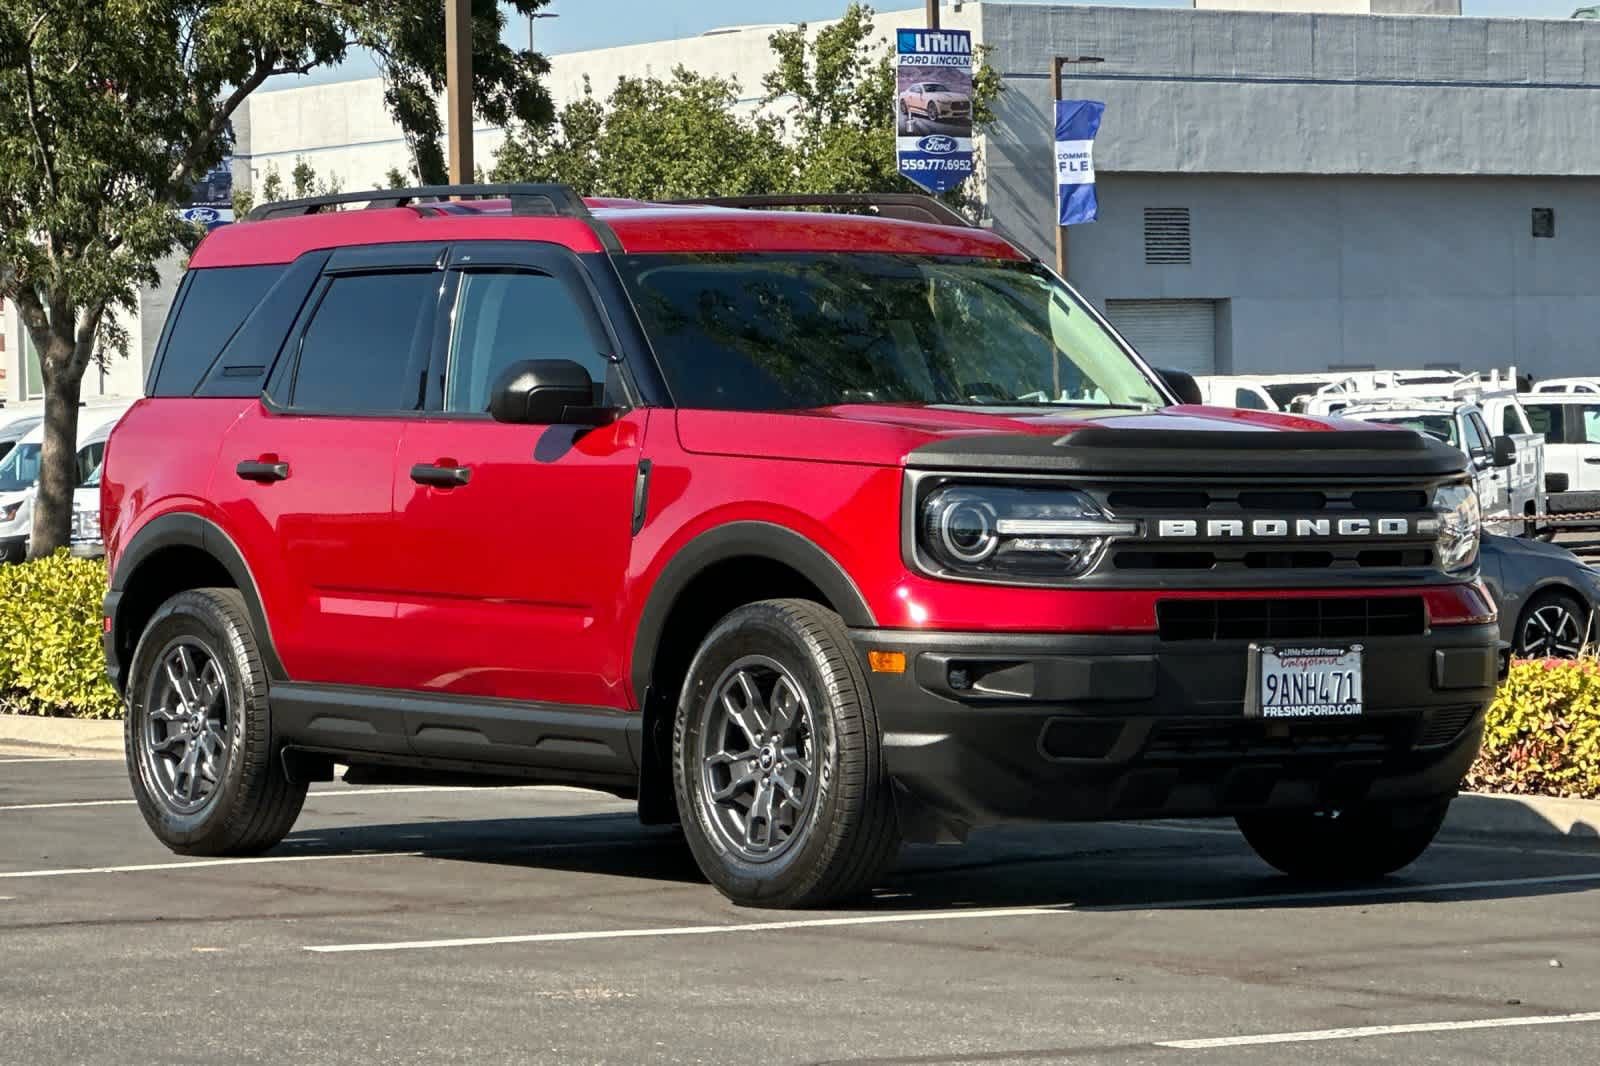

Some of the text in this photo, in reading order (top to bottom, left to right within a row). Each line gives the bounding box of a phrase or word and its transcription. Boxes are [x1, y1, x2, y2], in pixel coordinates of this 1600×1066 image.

[915, 32, 970, 53] LITHIA
[900, 55, 970, 66] FORD LINCOLN
[925, 137, 953, 152] Ford
[1058, 152, 1091, 160] COMME
[901, 159, 972, 171] 559.777.6952
[1159, 518, 1409, 537] BRONCO
[1281, 656, 1344, 672] California
[1266, 672, 1357, 705] 9ANH471
[1263, 704, 1362, 717] FRESNOFORD.COM
